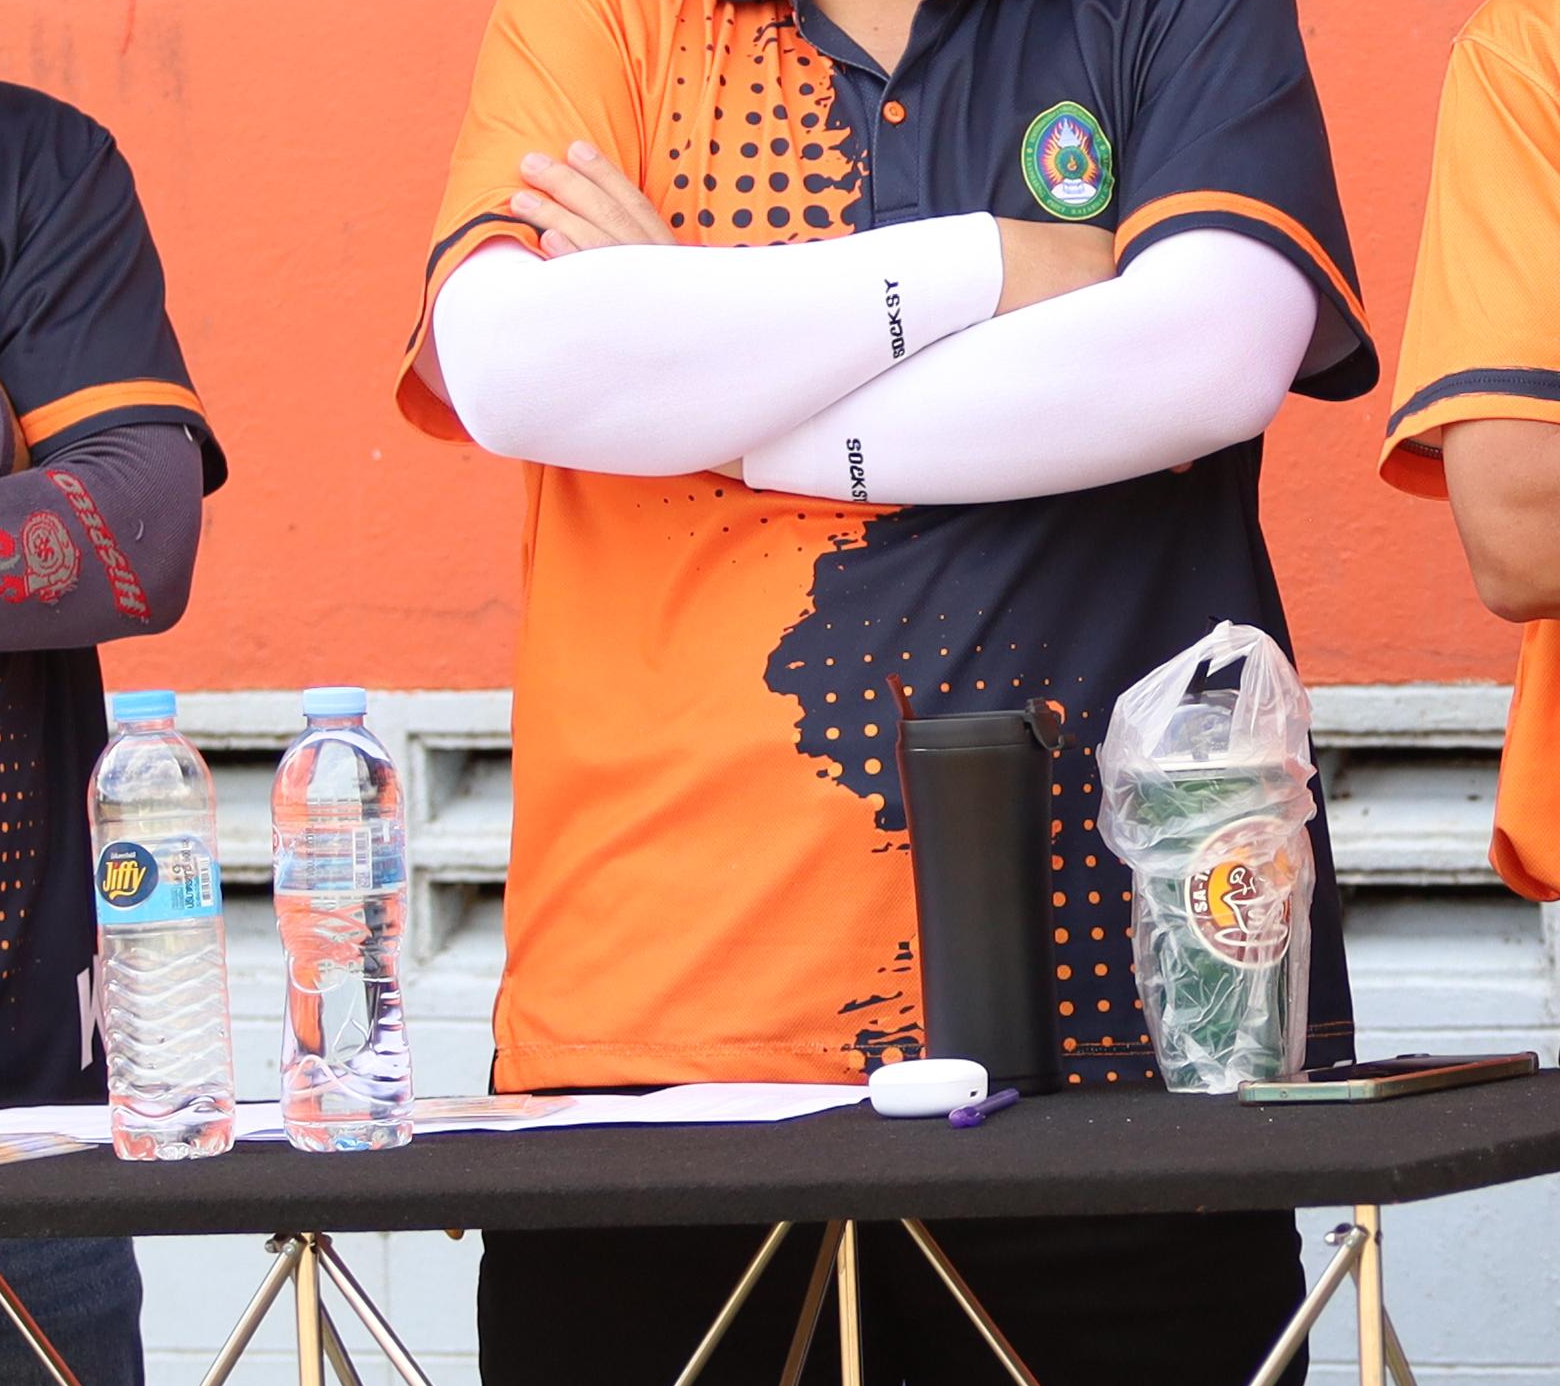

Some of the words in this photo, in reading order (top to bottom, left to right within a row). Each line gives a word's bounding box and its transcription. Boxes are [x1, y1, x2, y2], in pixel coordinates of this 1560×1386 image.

[883, 278, 906, 359] SOCKSY
[845, 437, 868, 503] SOCKS
[102, 860, 147, 900] Jiffy
[1192, 869, 1212, 915] SA-T
